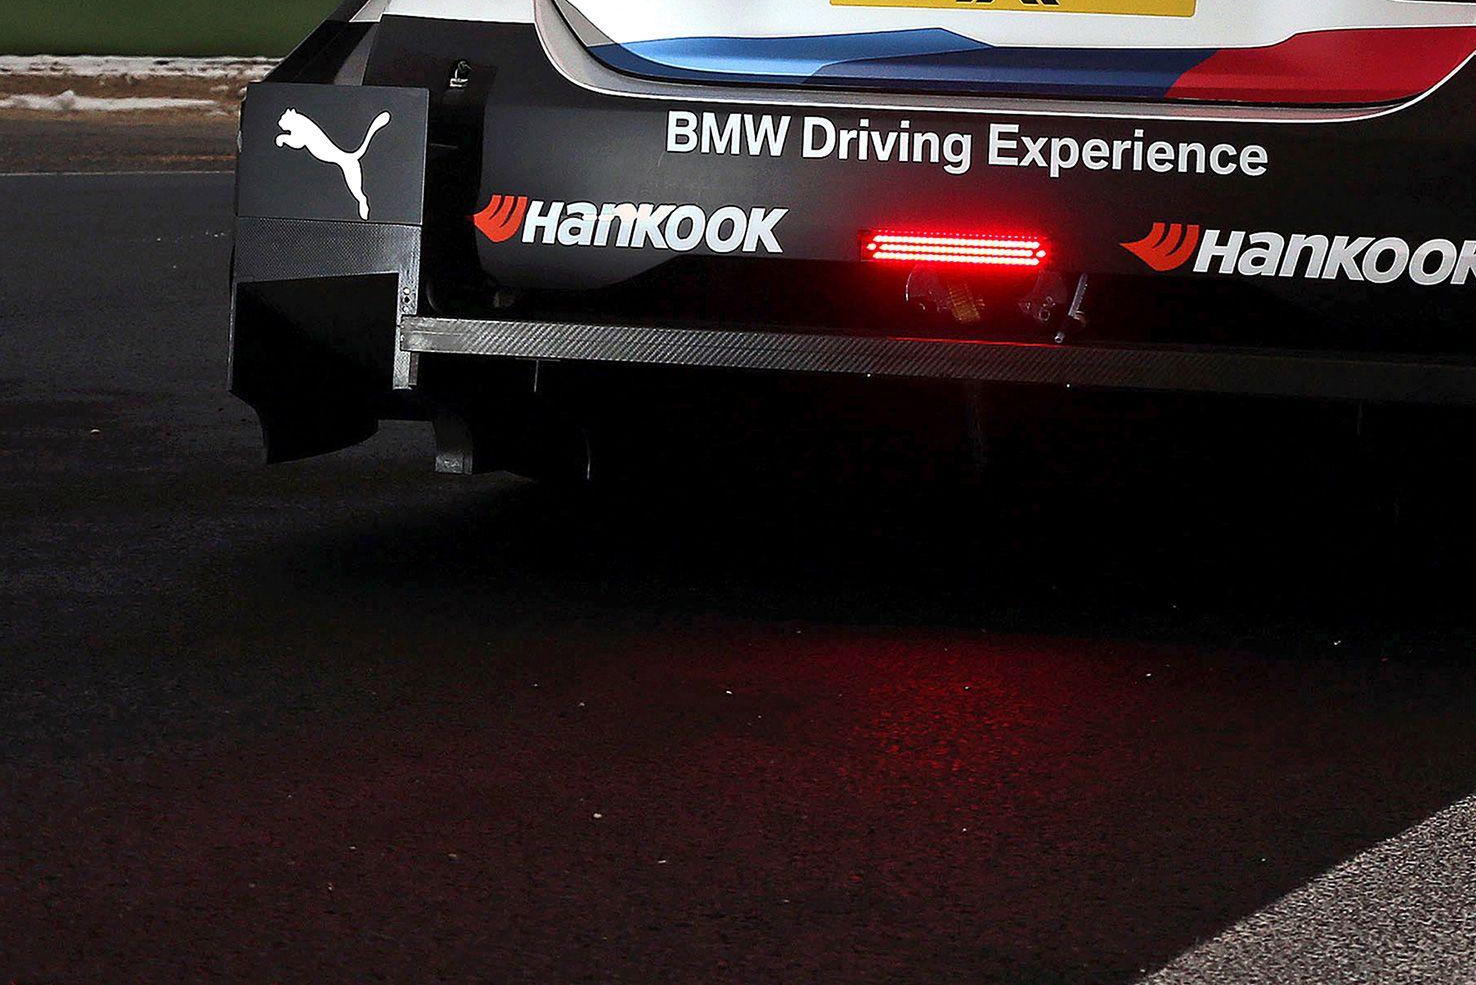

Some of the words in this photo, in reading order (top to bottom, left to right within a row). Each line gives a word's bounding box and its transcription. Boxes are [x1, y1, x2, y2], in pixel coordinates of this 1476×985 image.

[666, 109, 791, 158] BMW
[803, 116, 972, 174] Driving
[988, 123, 1269, 177] Experience
